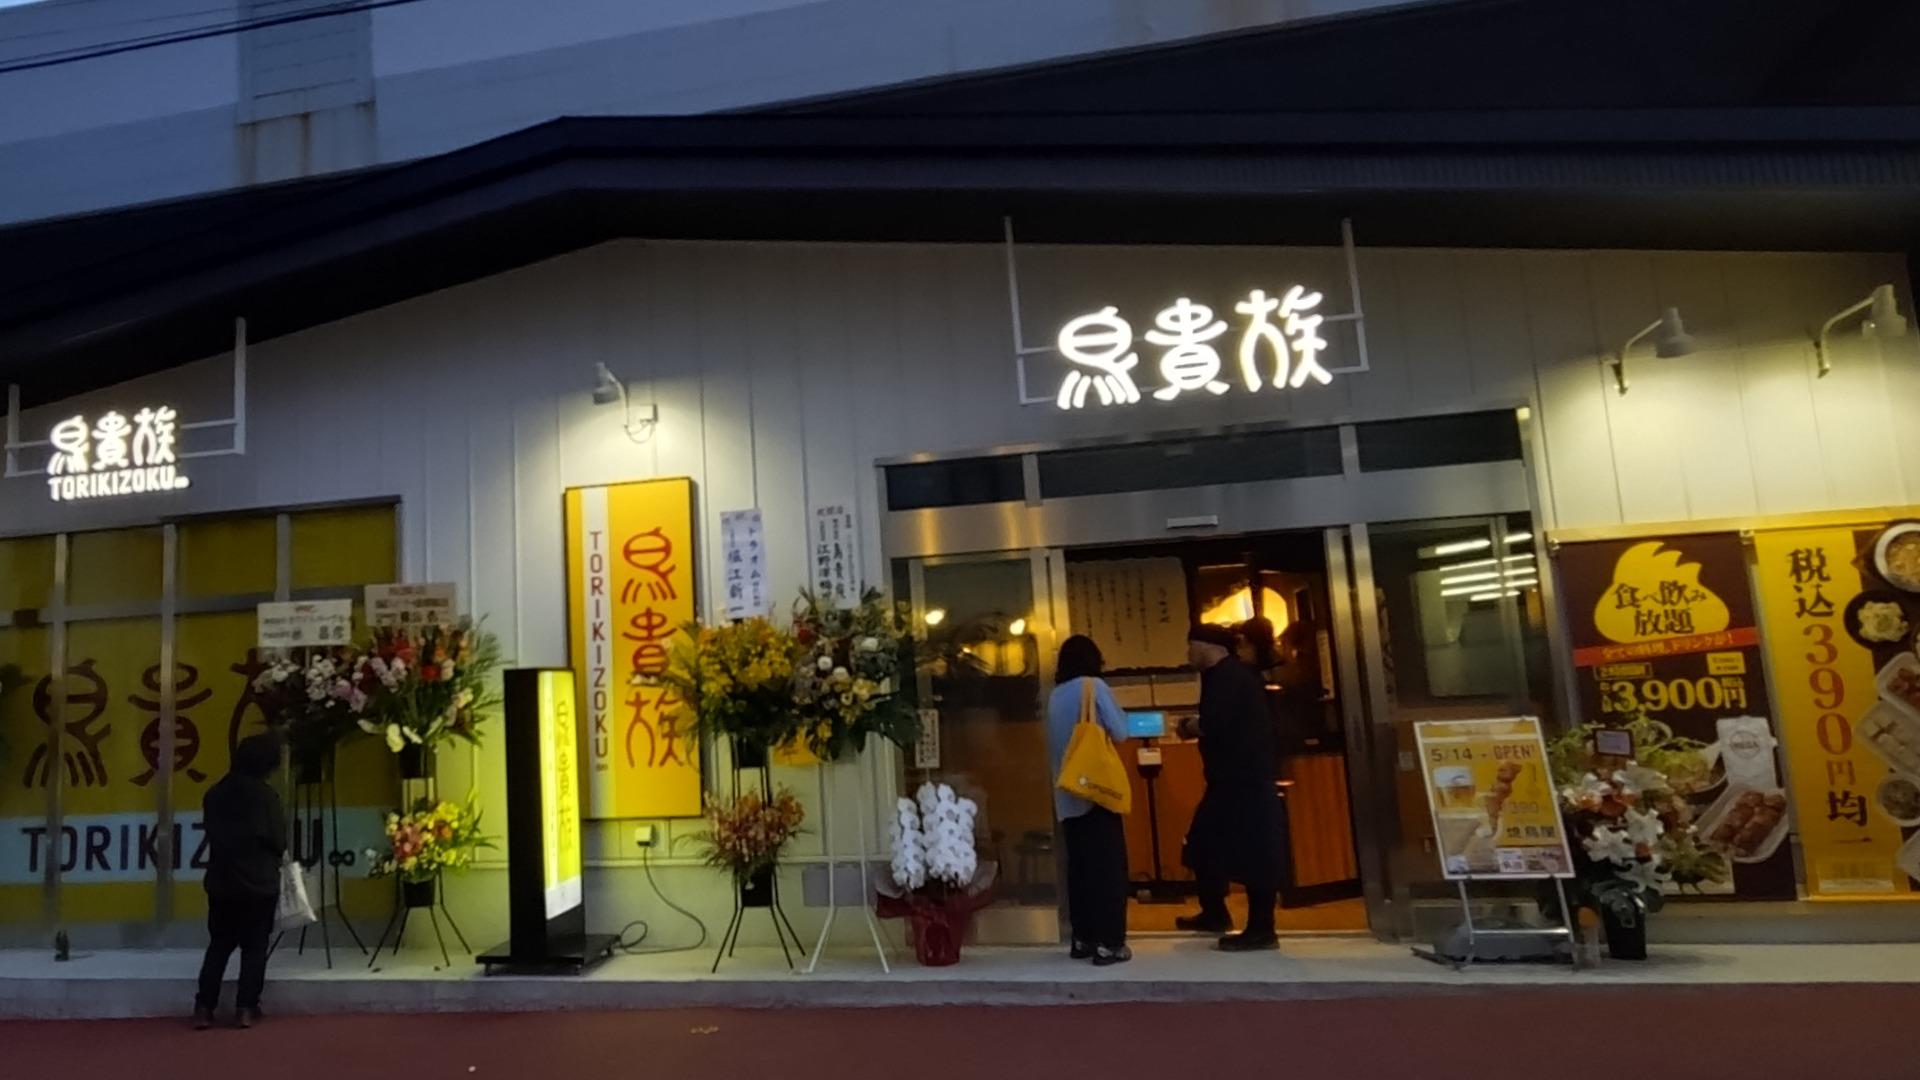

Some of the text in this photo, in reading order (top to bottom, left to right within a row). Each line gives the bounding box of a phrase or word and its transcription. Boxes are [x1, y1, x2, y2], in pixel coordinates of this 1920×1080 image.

[1057, 285, 1333, 410] 鳥貴族
[47, 406, 177, 475] 鳥貴族
[47, 465, 177, 502] TORIKIZOKU
[1614, 580, 1708, 610] 食べ飲み
[1633, 608, 1695, 637] 放題
[589, 531, 608, 758] TORIKIZOKU
[621, 526, 677, 768] 鳥貴族
[1611, 676, 1747, 713] 3,900円
[1787, 547, 1873, 844] 税込390円均一
[19, 816, 324, 874] TORIKIZU
